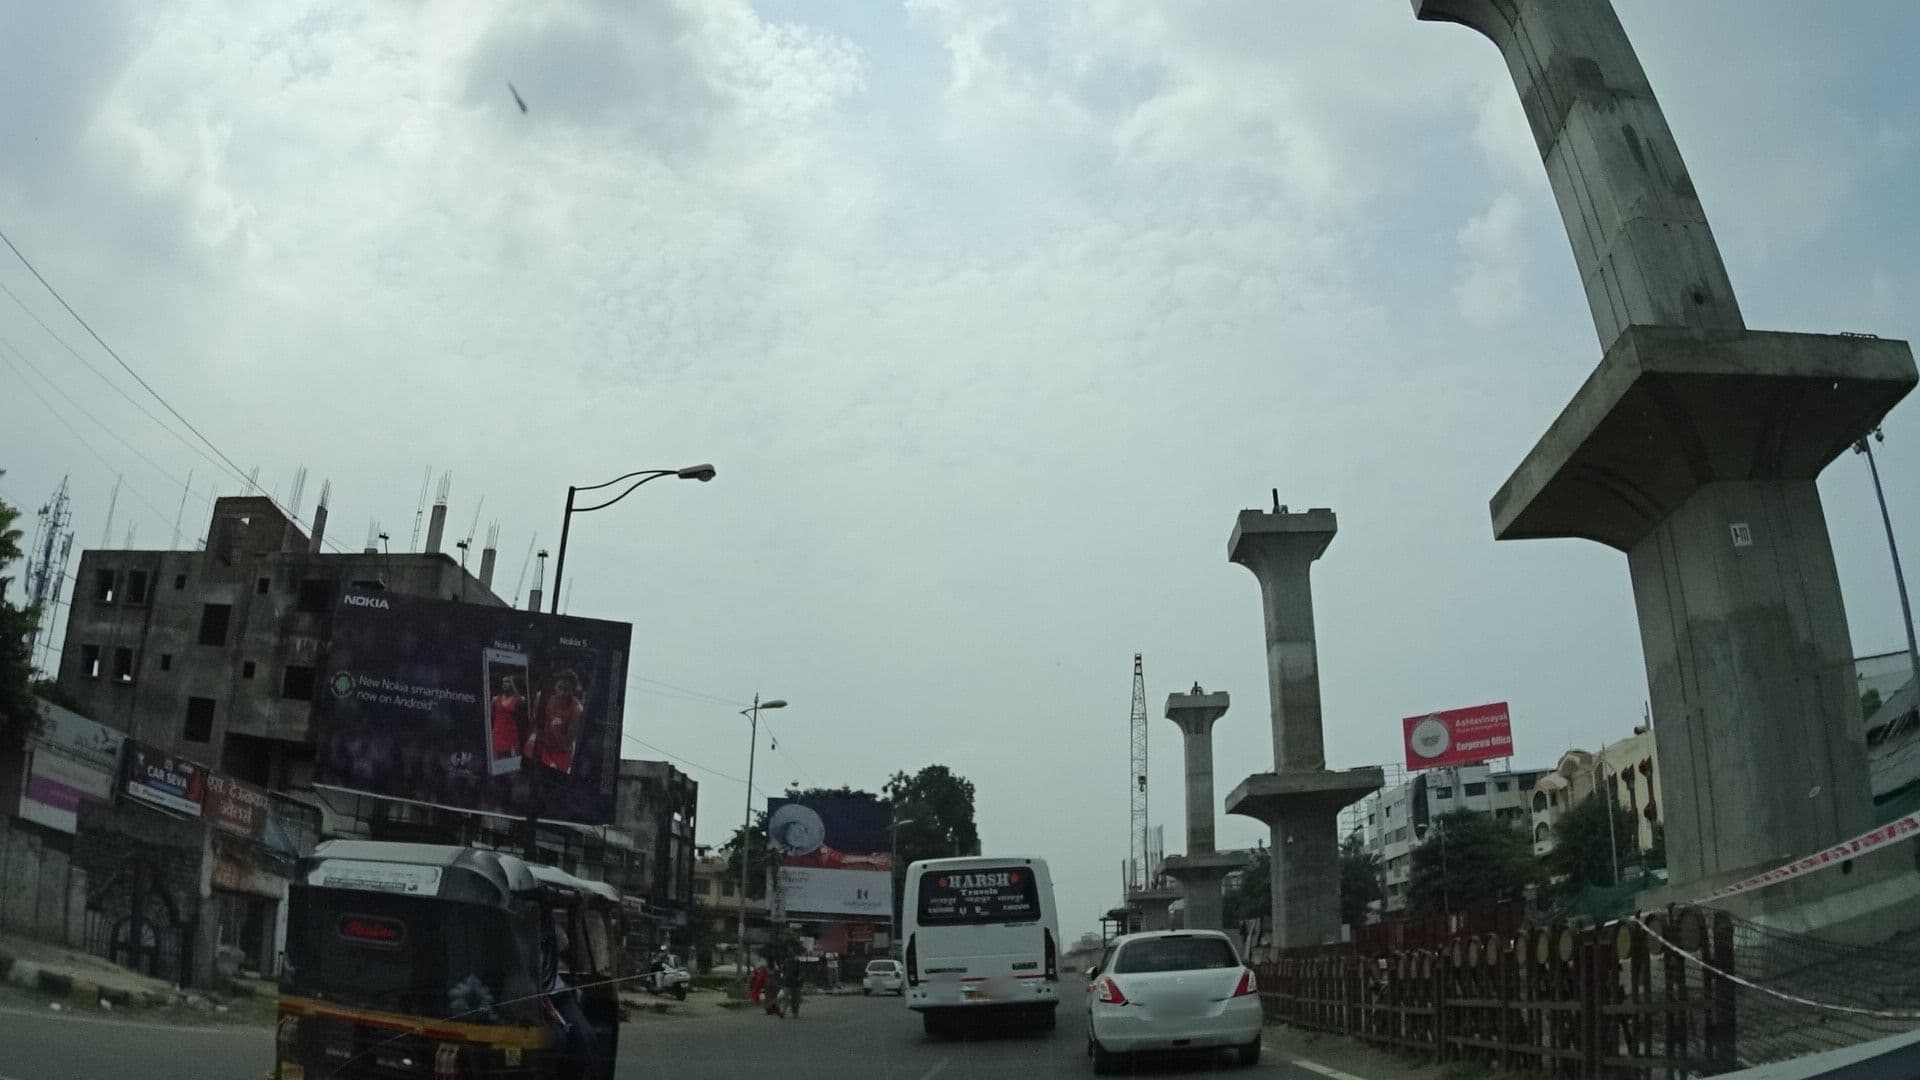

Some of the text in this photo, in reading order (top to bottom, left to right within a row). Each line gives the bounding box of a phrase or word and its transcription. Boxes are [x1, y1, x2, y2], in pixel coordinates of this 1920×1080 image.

[344, 594, 389, 610] NOKIA
[494, 640, 514, 650] Nokia
[560, 636, 582, 647] Nokia
[359, 675, 476, 704] New Nokia smartphones
[357, 691, 377, 703] now
[379, 695, 393, 704] on
[1491, 735, 1511, 747] Office
[147, 765, 164, 781] CAR
[166, 772, 187, 790] SEVA
[948, 873, 1009, 889] HARSH
[960, 889, 998, 897] Travels
